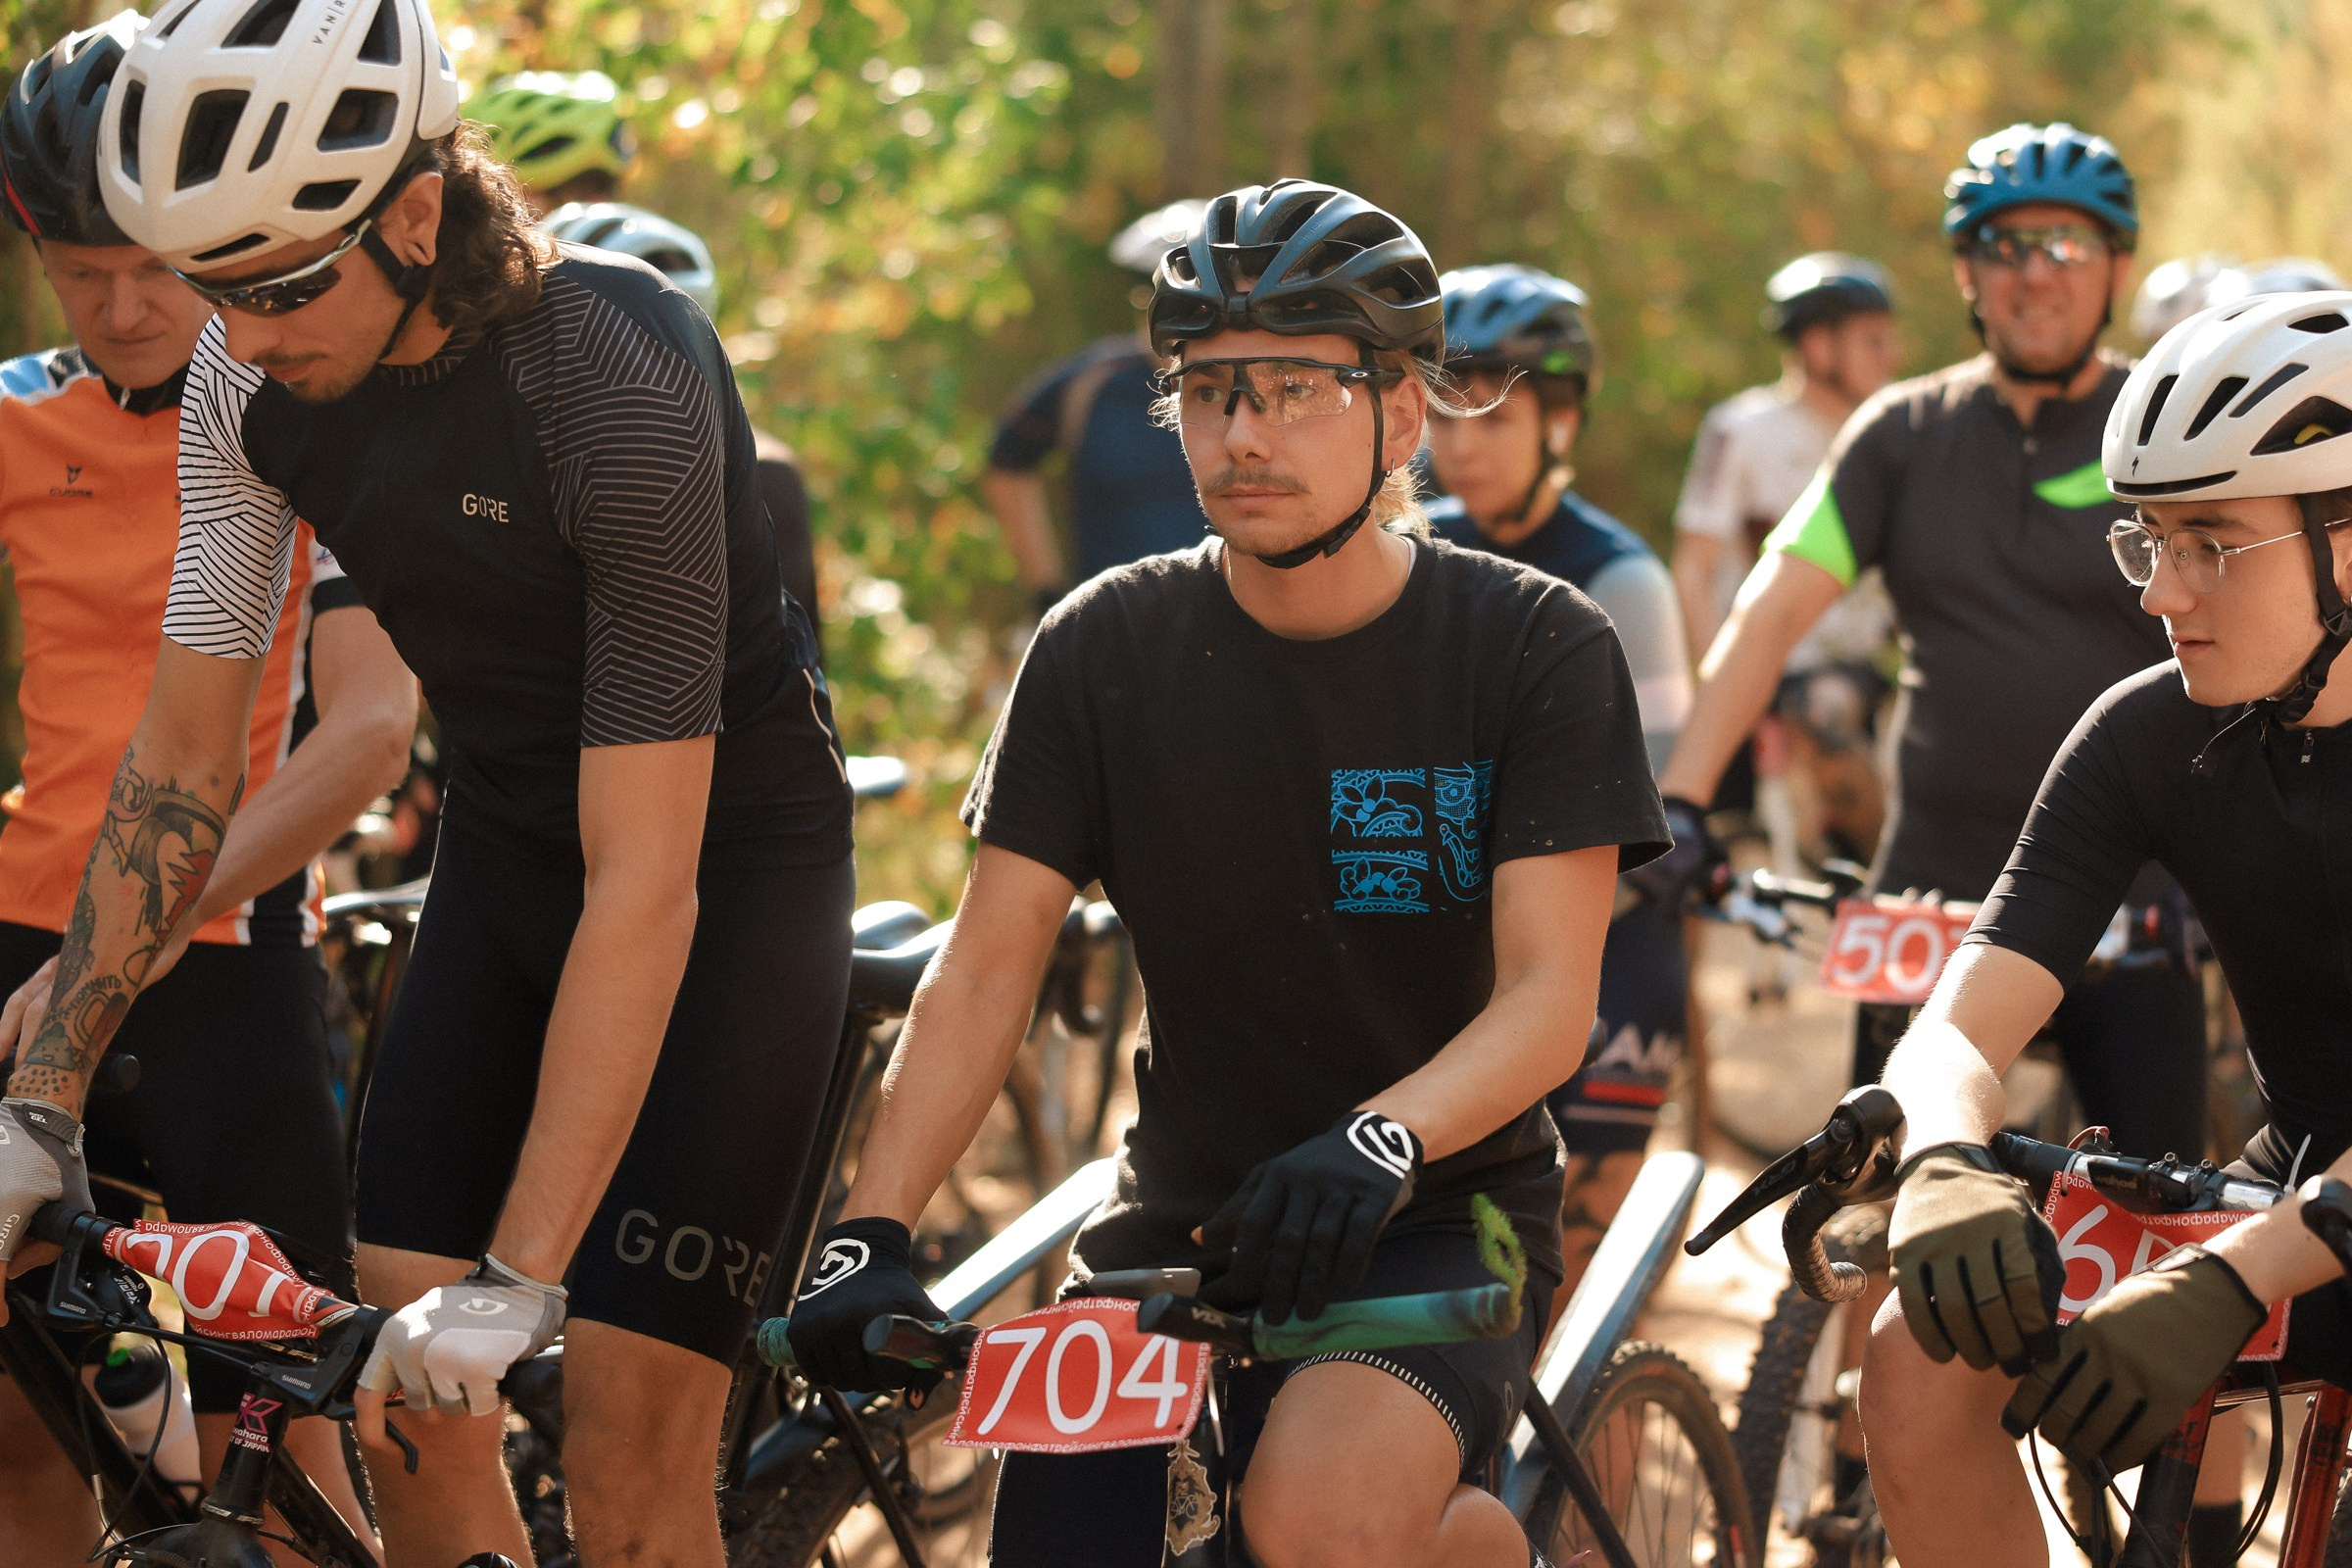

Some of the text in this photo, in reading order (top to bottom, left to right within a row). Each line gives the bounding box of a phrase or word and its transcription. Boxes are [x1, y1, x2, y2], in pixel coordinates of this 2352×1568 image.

[463, 493, 509, 523] GORE
[1832, 914, 1967, 996] 50
[614, 1208, 772, 1308] GORE
[59, 1300, 87, 1315] SHIMANO
[281, 1374, 312, 1390] SHIMANO
[977, 1319, 1189, 1436] 704
[242, 1440, 270, 1453] JAPAN
